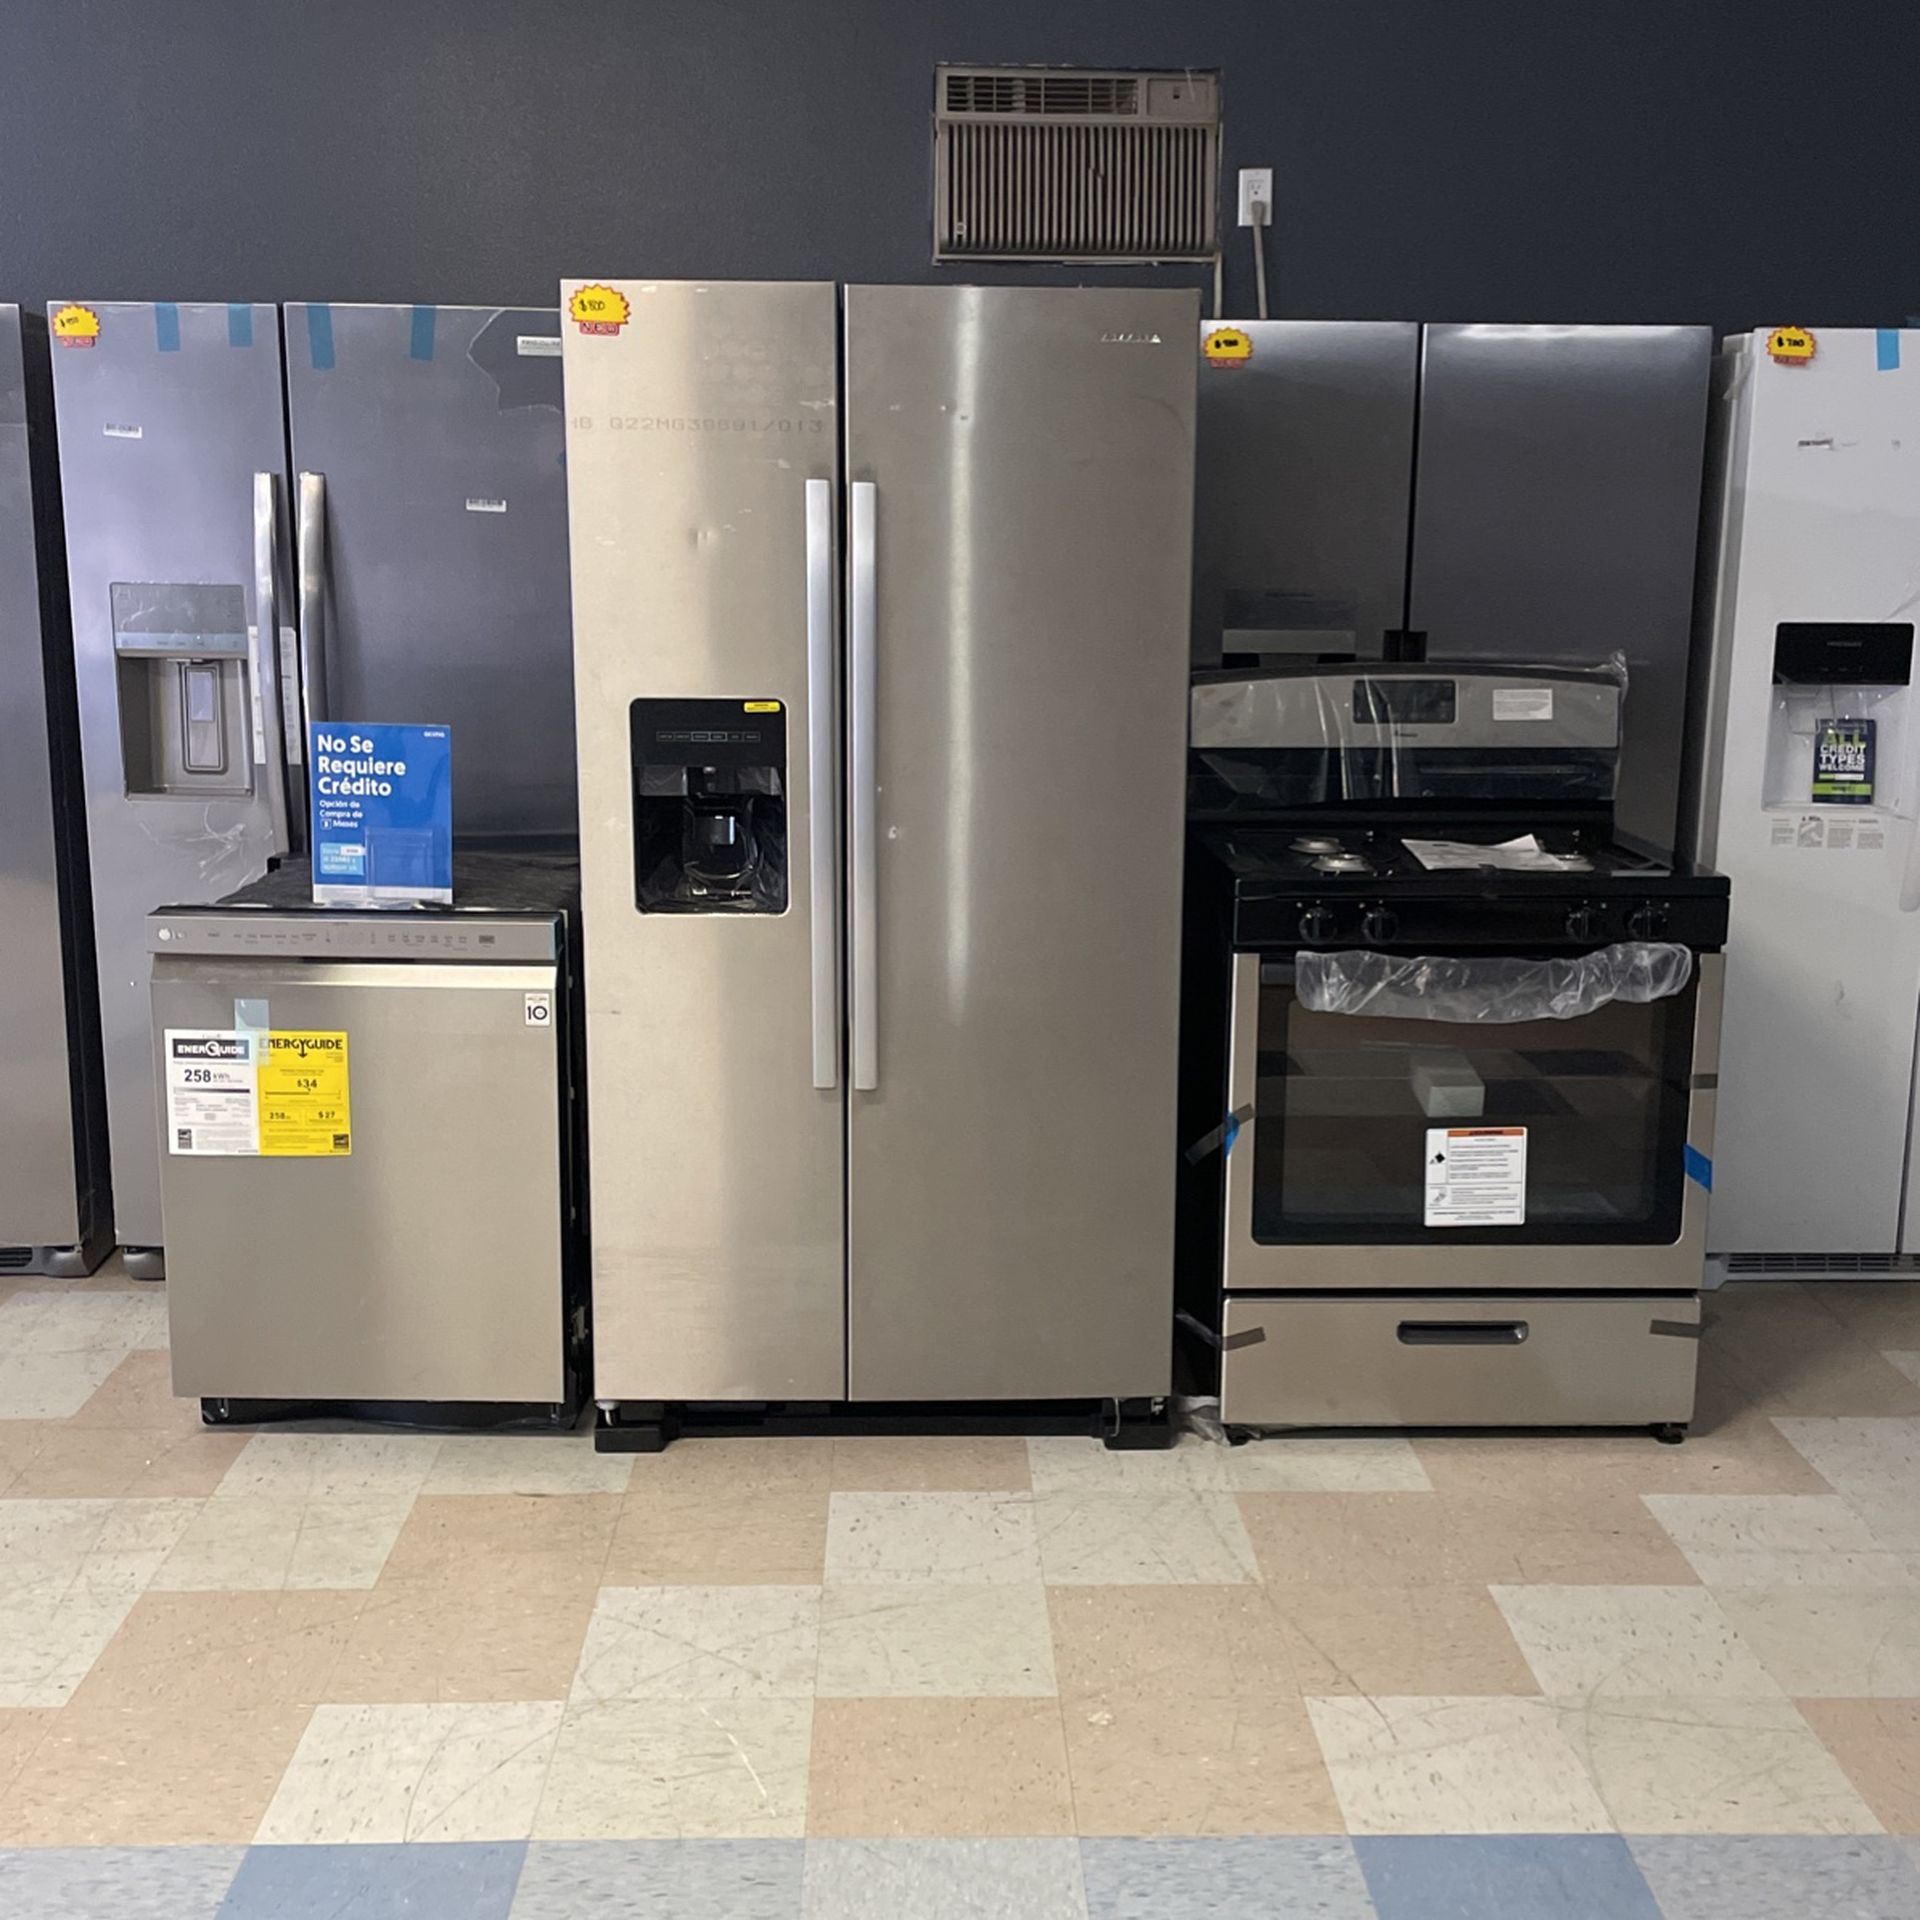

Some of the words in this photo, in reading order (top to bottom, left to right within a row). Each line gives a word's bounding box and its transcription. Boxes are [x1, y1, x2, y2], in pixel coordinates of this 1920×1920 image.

[318, 734, 346, 753] No
[350, 735, 374, 753] Se
[1820, 744, 1866, 754] CREDIT
[318, 756, 406, 778] Requiere
[1820, 754, 1866, 765] TYPES
[318, 776, 392, 796] Crédito
[528, 1005, 548, 1020] 10
[184, 1069, 212, 1083] 258
